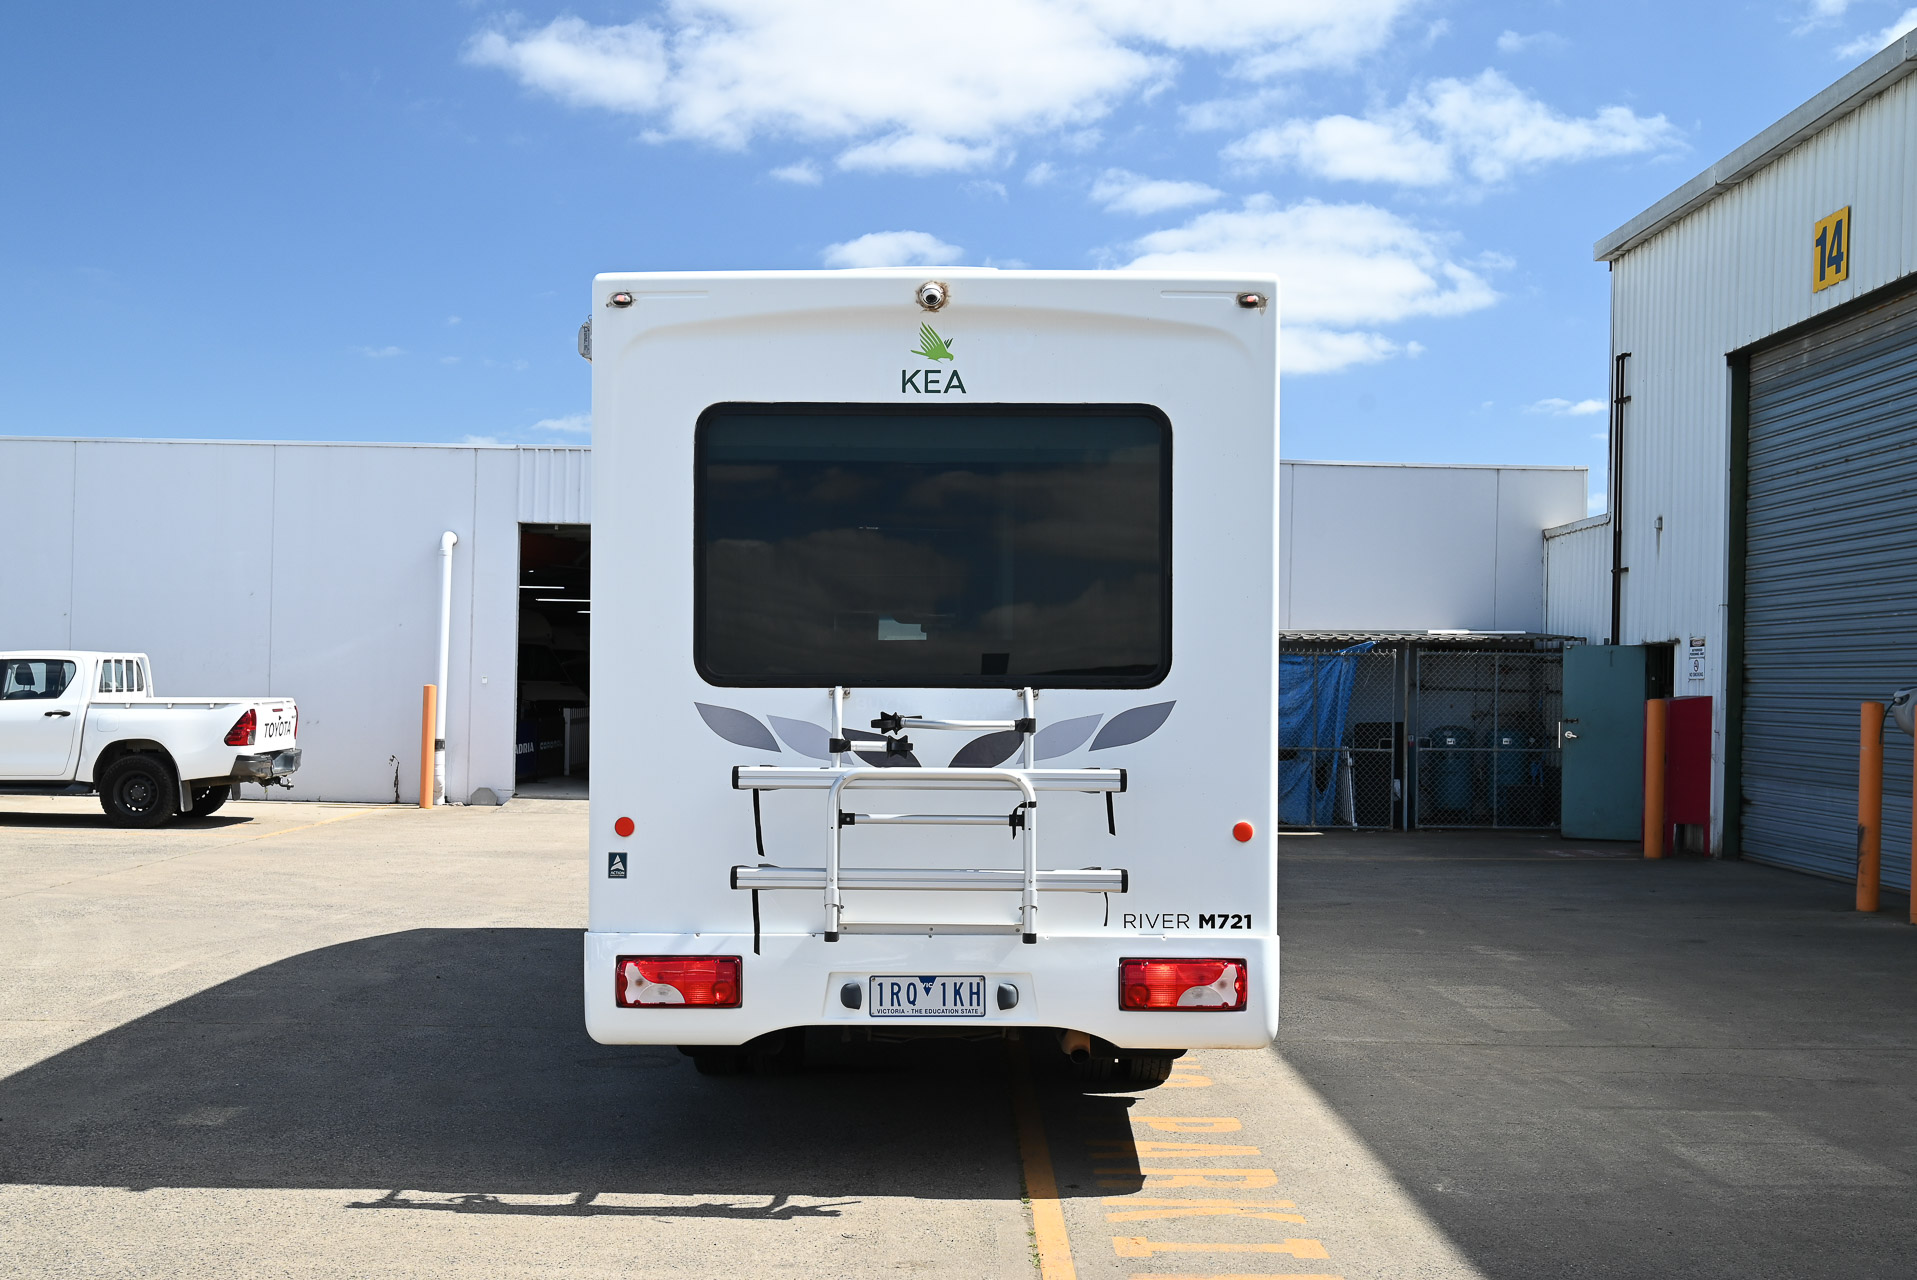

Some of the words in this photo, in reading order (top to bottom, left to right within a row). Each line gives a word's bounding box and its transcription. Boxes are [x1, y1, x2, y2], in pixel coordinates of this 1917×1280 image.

[1815, 218, 1844, 283] 14
[901, 369, 967, 394] KEA
[264, 720, 291, 738] TOYOTA
[1123, 913, 1190, 929] RIVER
[1198, 913, 1252, 930] M721
[877, 981, 918, 1007] 1RQ
[940, 981, 981, 1007] 1KH
